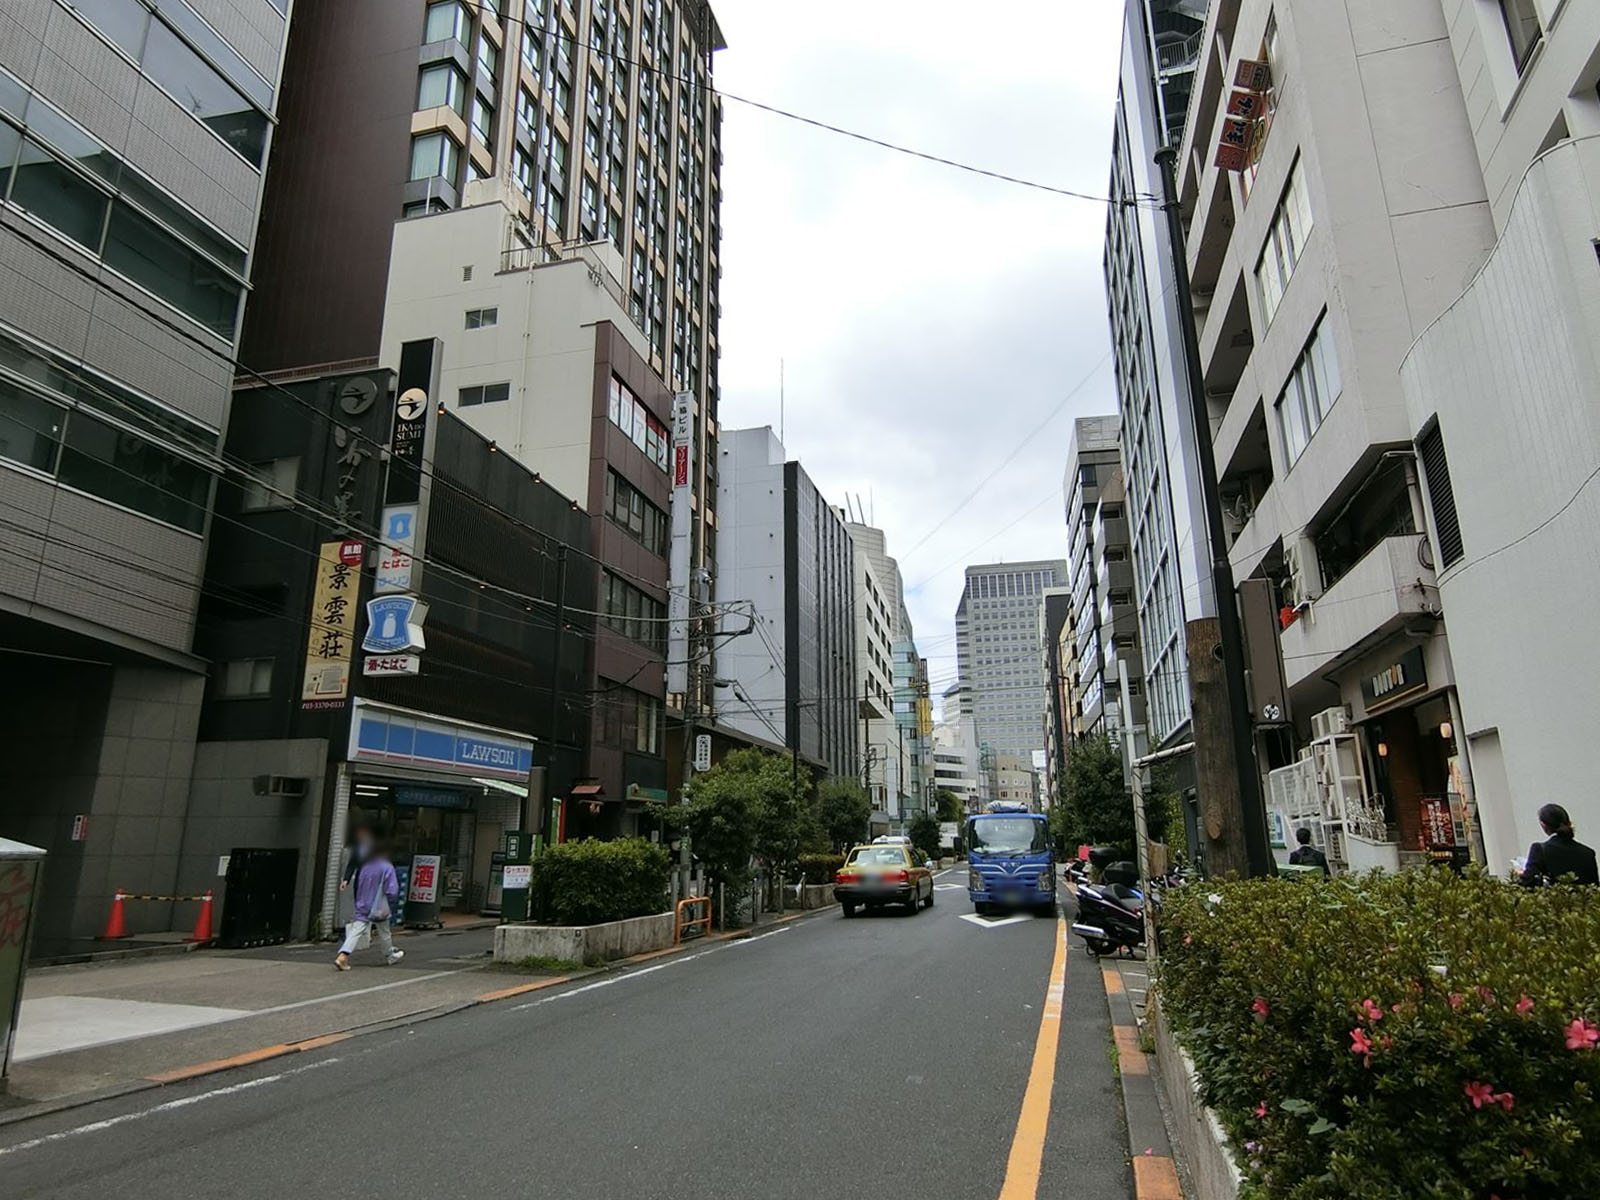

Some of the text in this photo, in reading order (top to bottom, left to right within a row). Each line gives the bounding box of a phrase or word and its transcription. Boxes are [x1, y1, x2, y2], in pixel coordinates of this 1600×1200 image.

[396, 430, 422, 441] SUMI
[381, 559, 410, 569] たばこ
[319, 562, 351, 659] 景雲荘
[461, 742, 515, 766] LAWSON
[414, 865, 435, 888] 酒
